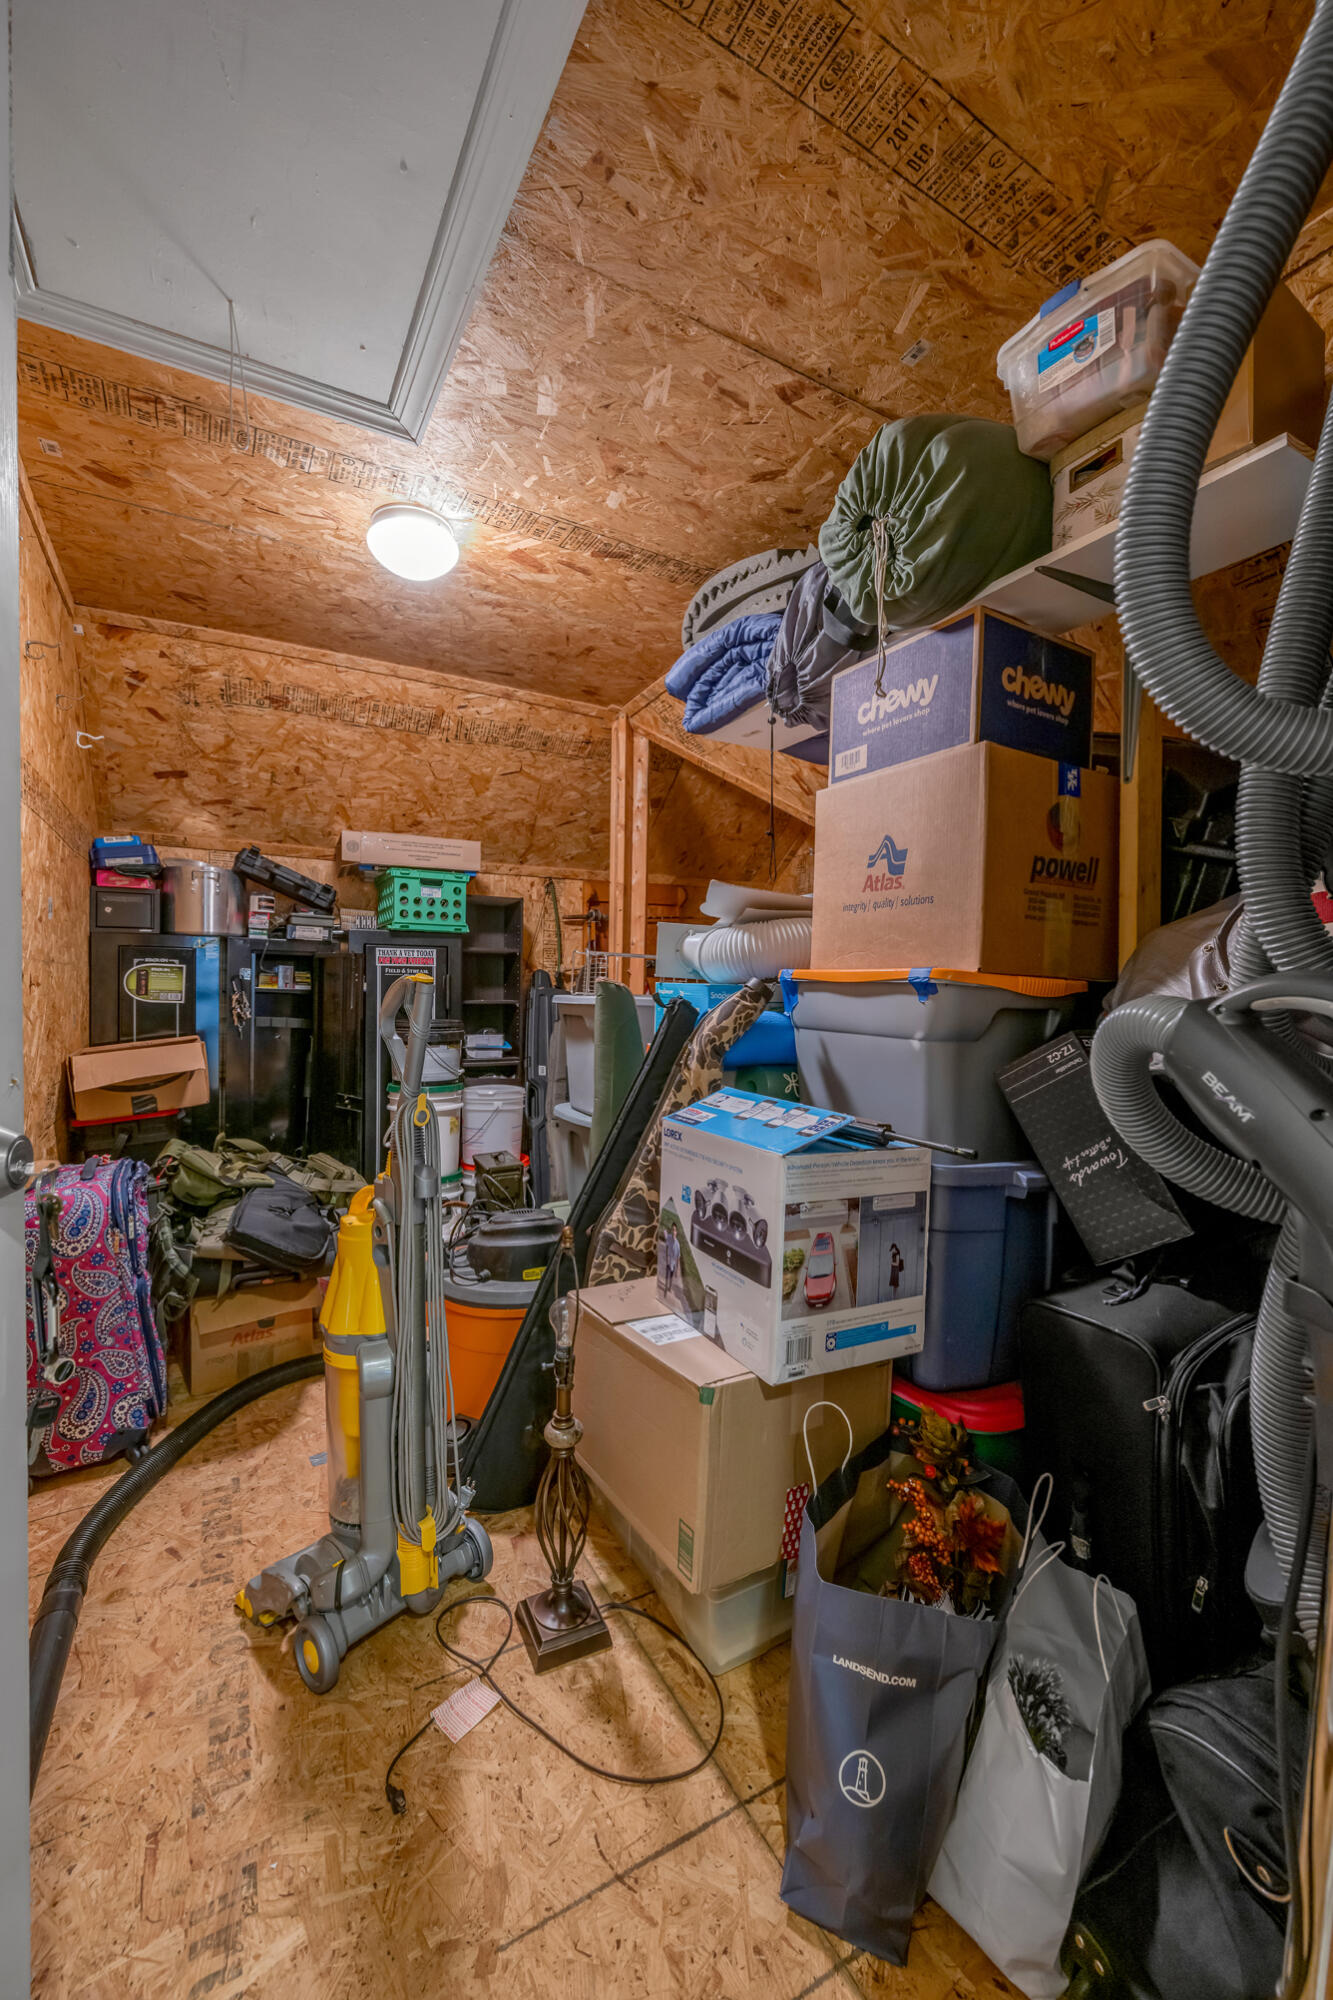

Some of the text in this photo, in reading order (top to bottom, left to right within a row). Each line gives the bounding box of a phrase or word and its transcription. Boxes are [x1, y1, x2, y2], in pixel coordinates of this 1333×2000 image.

[748, 0, 771, 25] IDE
[883, 111, 921, 152] 2011
[904, 140, 936, 173] DEC
[857, 674, 939, 725] chewy
[1001, 665, 1076, 716] chewy
[881, 721, 892, 732] pet
[893, 713, 913, 726] lovers
[914, 708, 930, 718] shop
[1030, 855, 1099, 884] powell
[862, 873, 902, 893] Atlas
[900, 895, 935, 907] solutions
[378, 949, 398, 957] THANK
[408, 957, 434, 965] FREEDOM
[1047, 1043, 1076, 1064] TZ-C2
[1201, 1071, 1255, 1122] BEAM
[664, 1127, 682, 1141] LOREX
[1069, 1148, 1128, 1187] Towards
[229, 1327, 273, 1346] Atlas
[831, 1654, 918, 1689] LANDSEND.COM
